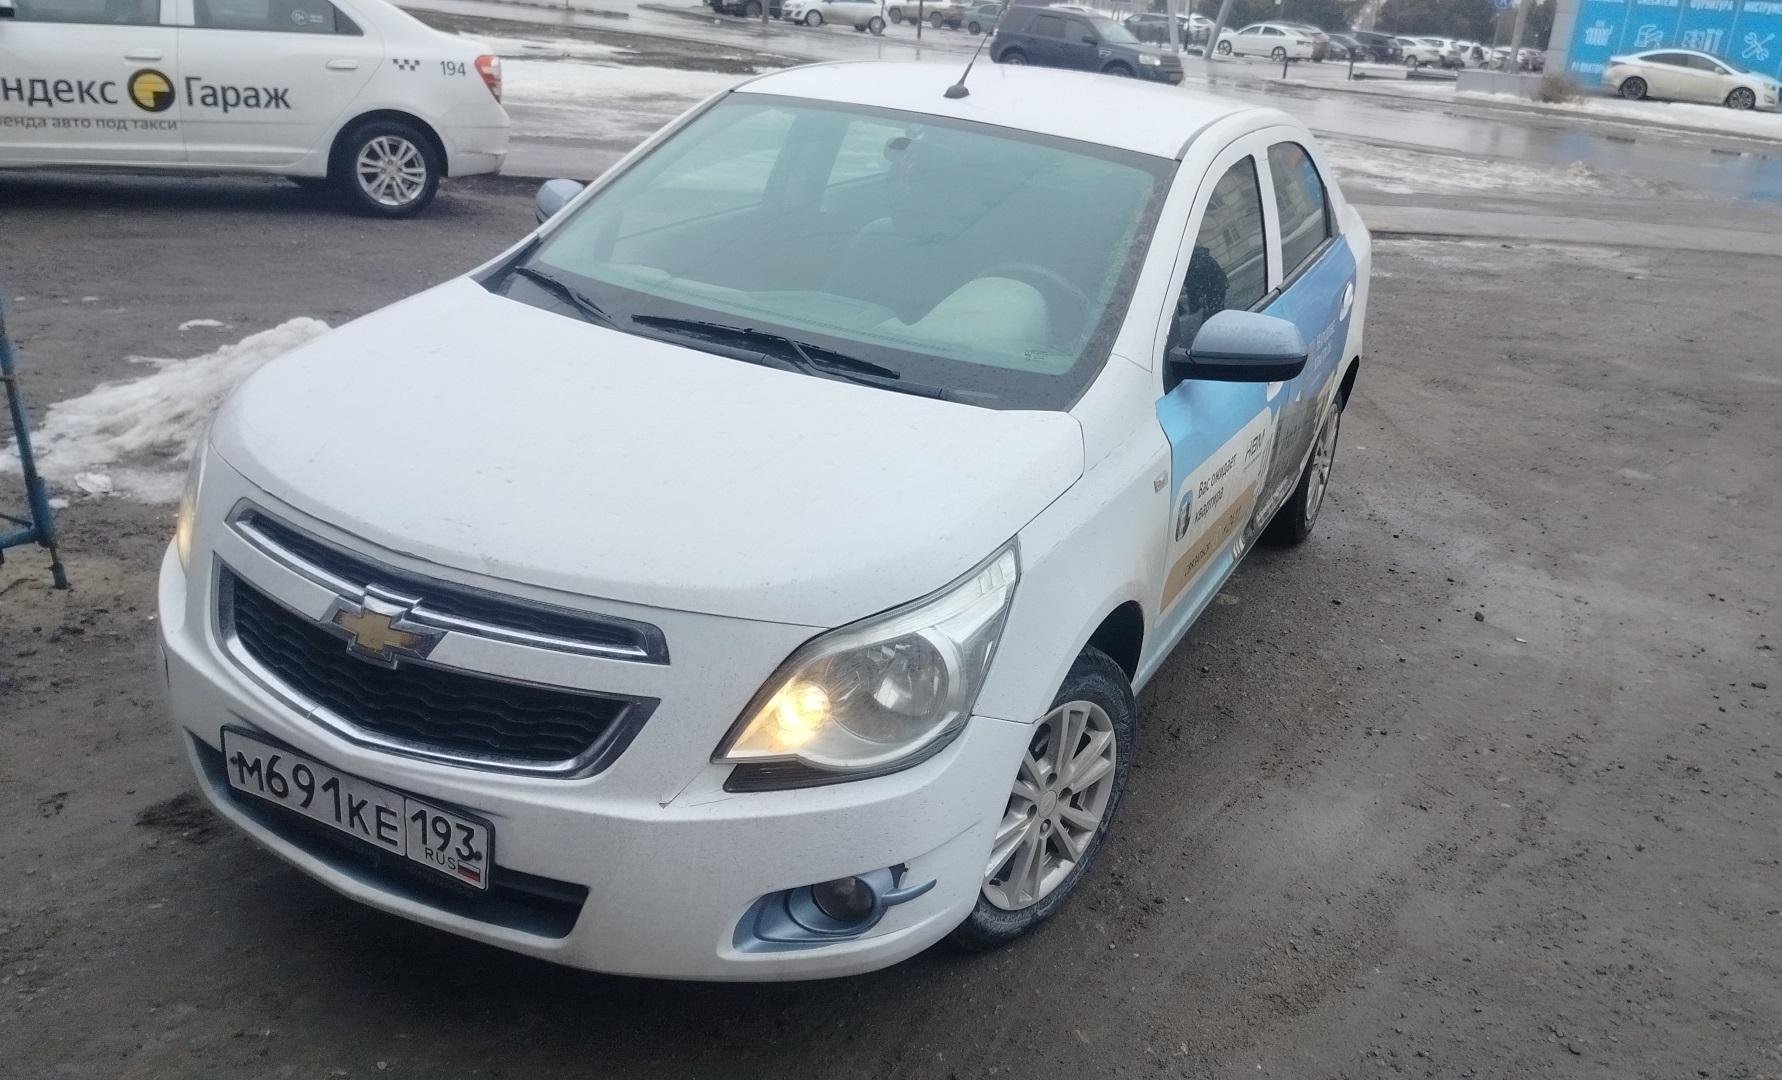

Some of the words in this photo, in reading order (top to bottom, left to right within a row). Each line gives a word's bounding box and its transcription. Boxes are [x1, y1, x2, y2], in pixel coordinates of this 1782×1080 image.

[439, 60, 466, 76] 194
[184, 76, 292, 113] Гараж
[52, 117, 91, 129] авто
[97, 118, 128, 130] под
[133, 119, 177, 130] такси
[410, 809, 476, 862] 193
[424, 847, 456, 871] RUS
